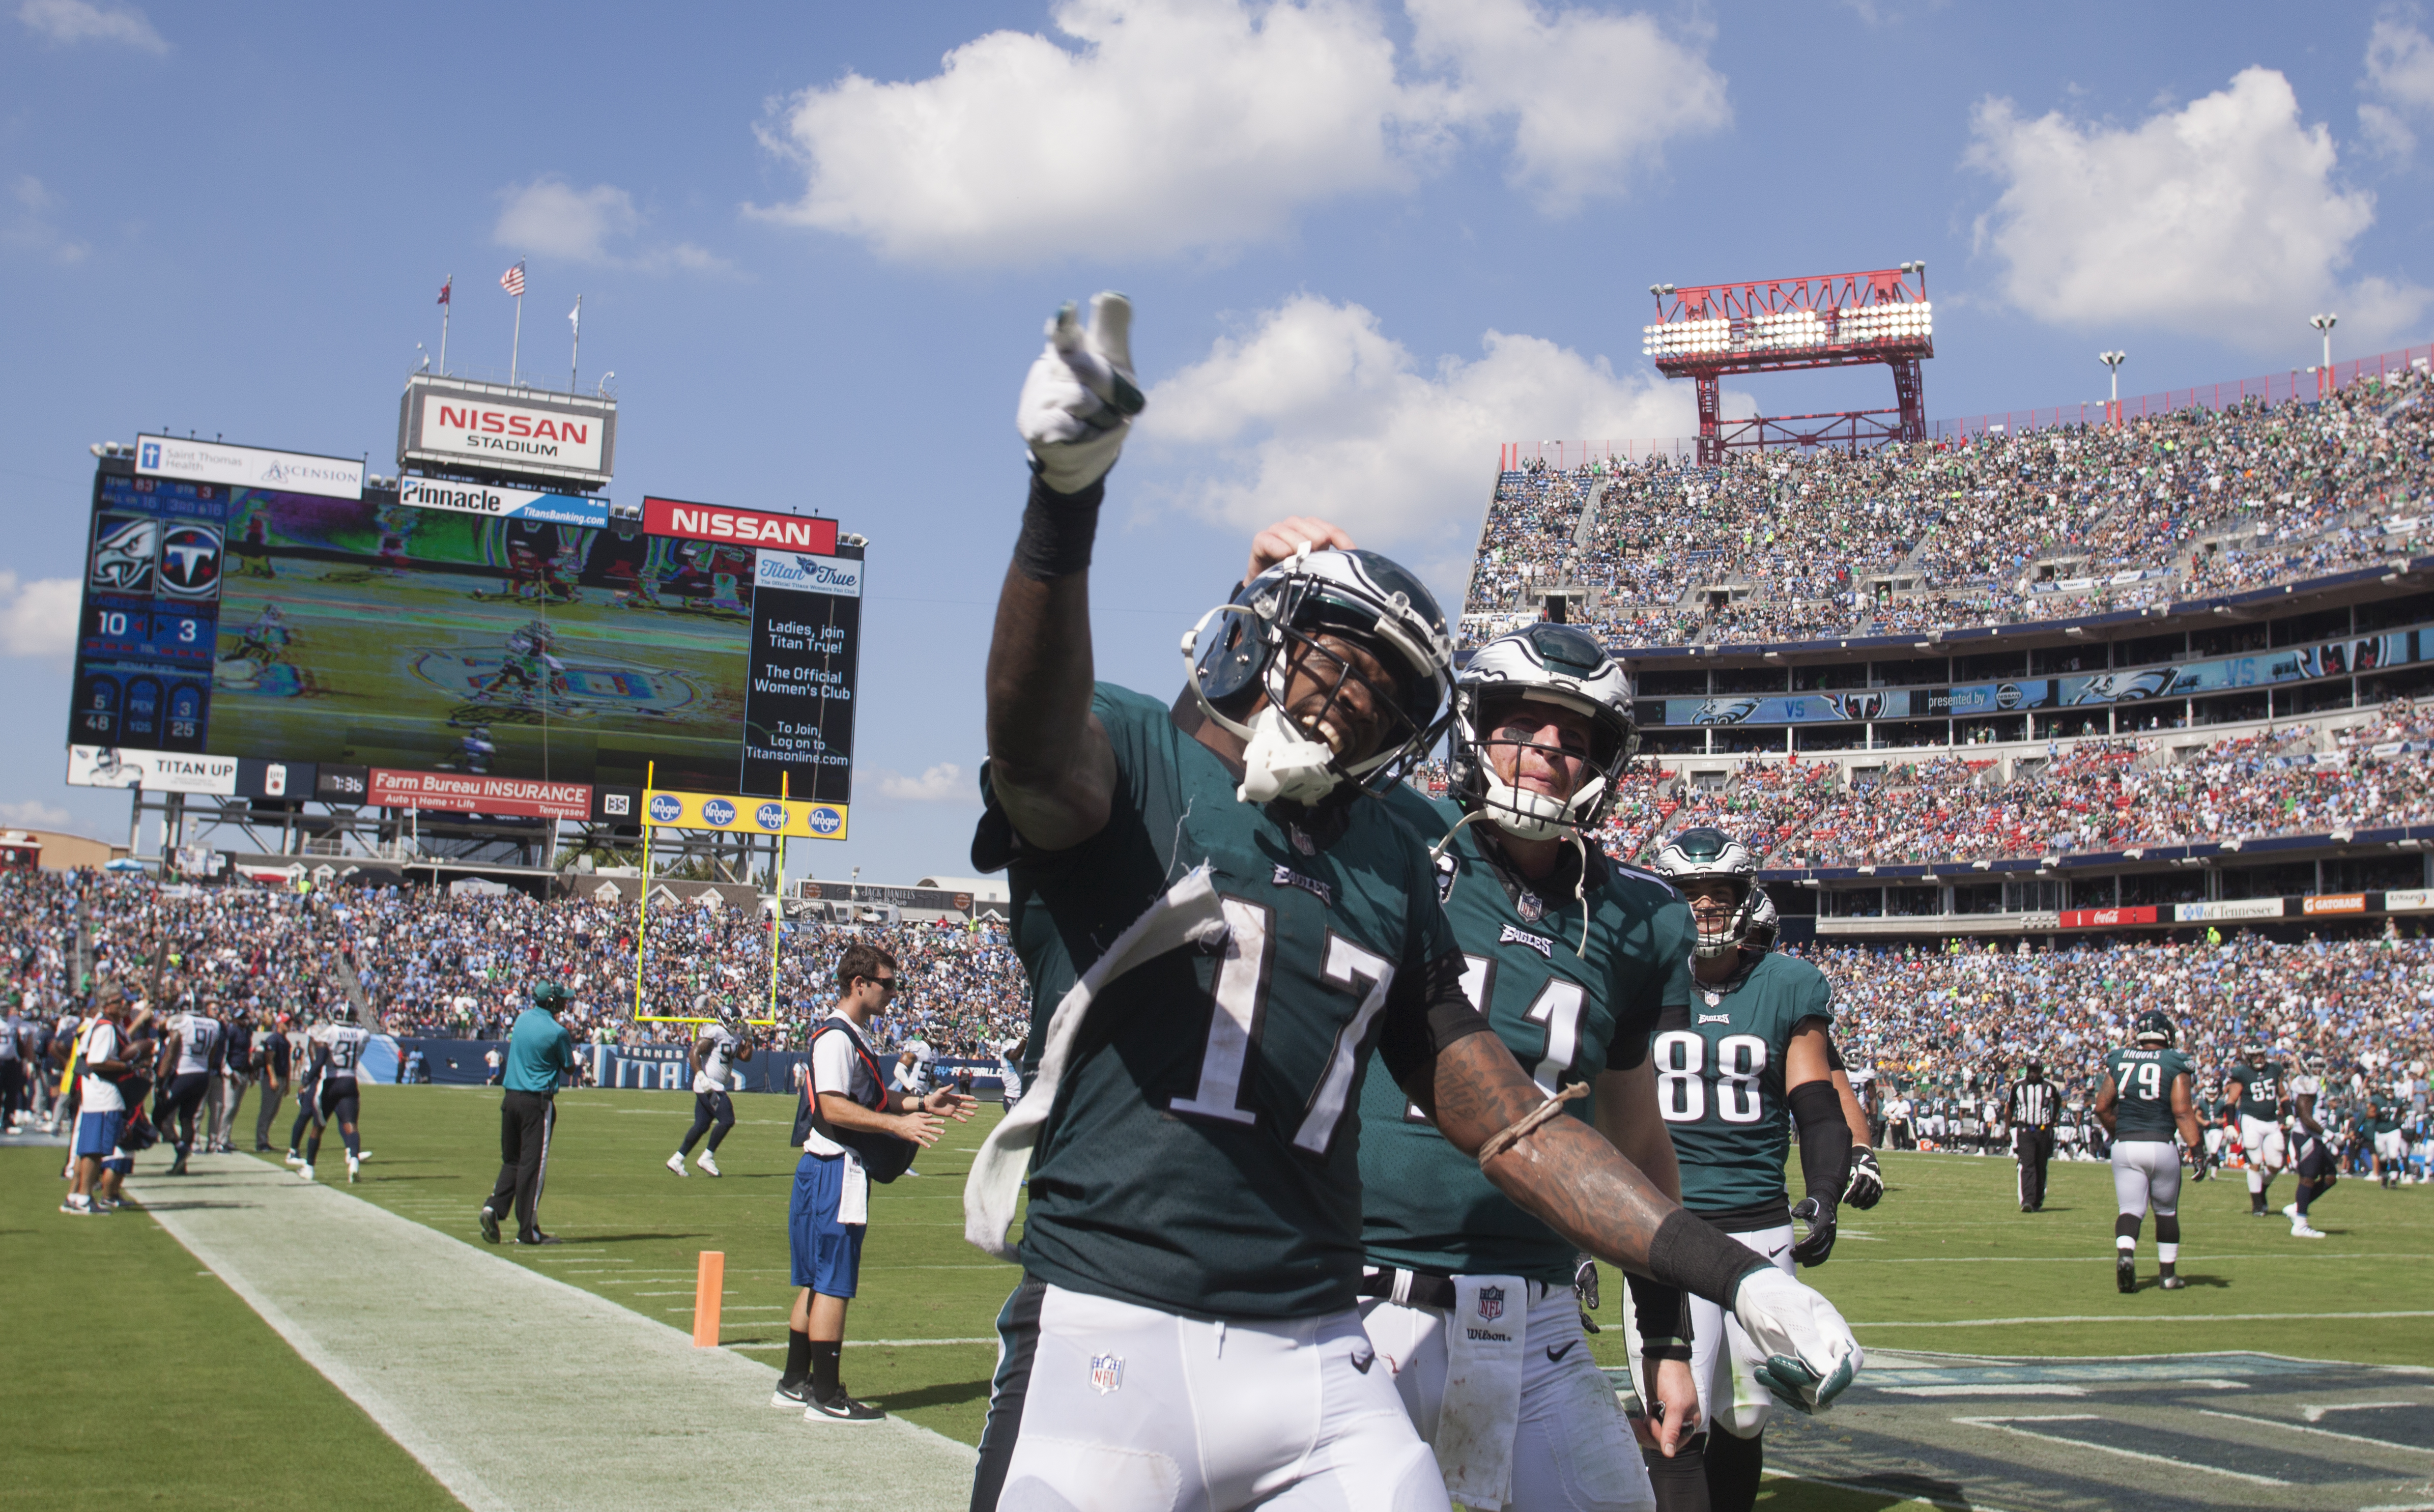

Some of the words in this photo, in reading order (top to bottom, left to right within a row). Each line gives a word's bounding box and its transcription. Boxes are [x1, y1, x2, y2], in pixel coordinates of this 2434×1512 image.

[440, 406, 587, 444] NISSAN
[467, 436, 557, 457] STADIUM
[165, 458, 204, 472] Health
[167, 448, 195, 461] Saint
[199, 451, 243, 466] Thomas
[268, 464, 358, 482] ASCENSION
[203, 486, 212, 499] 3
[404, 480, 501, 511] Pinnacle
[524, 506, 605, 526] TitansBanking.com
[672, 508, 811, 546] NISSAN
[760, 559, 806, 581] Titan
[816, 565, 857, 586] True
[99, 610, 127, 635] 10
[180, 619, 197, 642] 3
[768, 619, 815, 638] Ladies,
[820, 624, 845, 640] join
[769, 634, 803, 650] Titan
[807, 638, 842, 654] True!
[766, 664, 790, 679] The
[793, 667, 842, 684] Official
[2224, 658, 2255, 687] VS
[755, 678, 817, 697] Women's
[821, 685, 851, 700] Club
[1996, 692, 2021, 700] NISSAN
[1928, 693, 1971, 708] presented
[1974, 690, 1985, 705] by
[180, 702, 191, 717] 3
[1785, 700, 1805, 718] VS
[777, 721, 792, 733] To
[770, 734, 793, 750] Log
[795, 739, 810, 750] on
[814, 739, 825, 751] to
[746, 746, 848, 766] Titansonline.com
[157, 759, 207, 775] TITAN
[212, 764, 234, 777] UP
[332, 775, 363, 793] 7:36
[376, 772, 419, 790] Farm
[422, 776, 481, 794] Bureau
[484, 781, 587, 803] INSURANCE
[385, 794, 409, 804] Auto
[419, 795, 447, 807] Home
[456, 799, 476, 809] Life
[539, 805, 585, 817] Tennessee
[610, 797, 626, 812] 35
[651, 797, 680, 820] Kroger
[705, 802, 734, 824] Kroger
[758, 806, 787, 828] Kroger
[811, 810, 840, 832] Kroger
[861, 886, 882, 898] JACK
[884, 888, 915, 900] DANIEL'S
[1272, 863, 1332, 907] EAGLES
[868, 897, 907, 906] Bar-B-Que
[1522, 902, 1537, 917] NFL
[2204, 906, 2215, 918] of
[2218, 904, 2274, 917] Tennessee
[2304, 898, 2314, 912] G
[2315, 897, 2363, 910] GATORADE
[2094, 909, 2118, 924] Coca-Cola
[1499, 923, 1555, 959] EAGLES
[1169, 898, 1396, 1154] 17
[1698, 1013, 1730, 1025] EAGLES
[192, 1029, 213, 1055] 91
[334, 1041, 358, 1069] 31
[1653, 1030, 1767, 1122] 88
[2117, 1062, 2161, 1100] 79
[1479, 1300, 1501, 1318] NFL
[1467, 1328, 1506, 1342] Wilson
[1094, 1370, 1115, 1386] NFL
